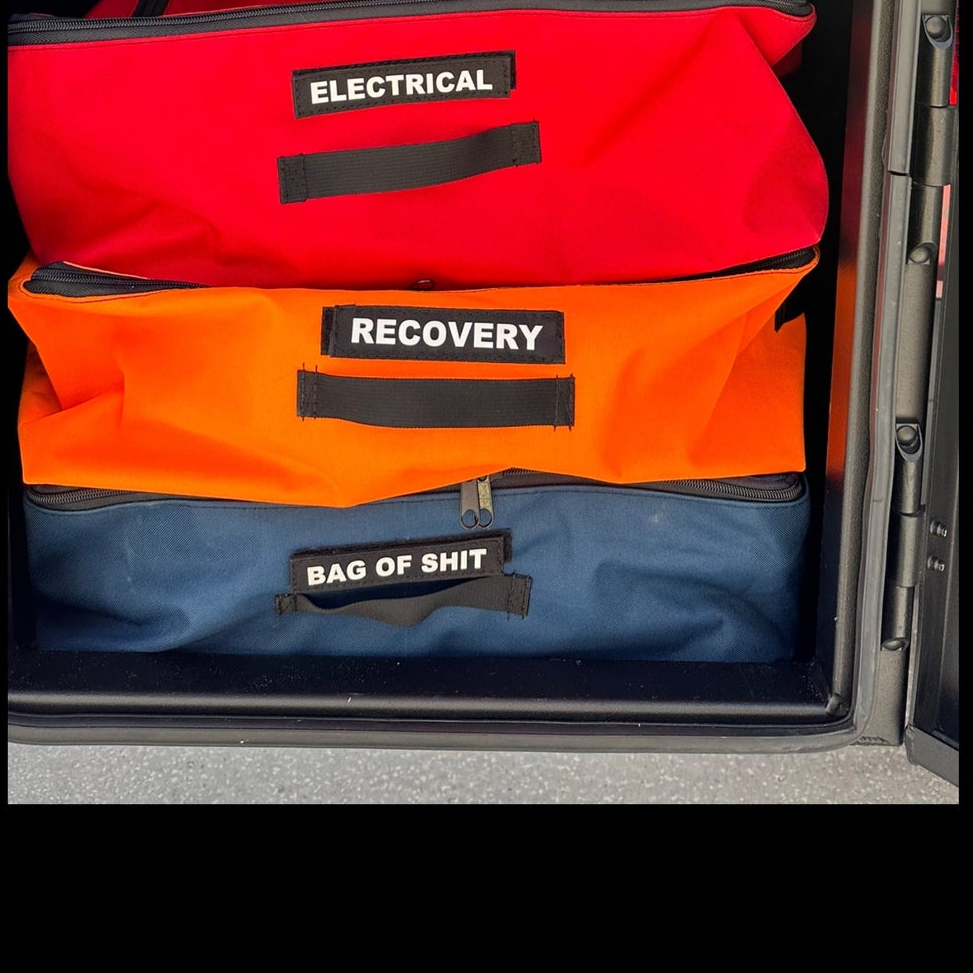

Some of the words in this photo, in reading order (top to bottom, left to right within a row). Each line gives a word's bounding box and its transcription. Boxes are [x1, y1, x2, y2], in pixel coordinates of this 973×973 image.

[310, 69, 493, 105] ELECTRICAL
[350, 317, 544, 351] RECOVERY
[306, 560, 367, 586] BAG
[375, 554, 413, 577] OF
[421, 548, 487, 573] SHIT
